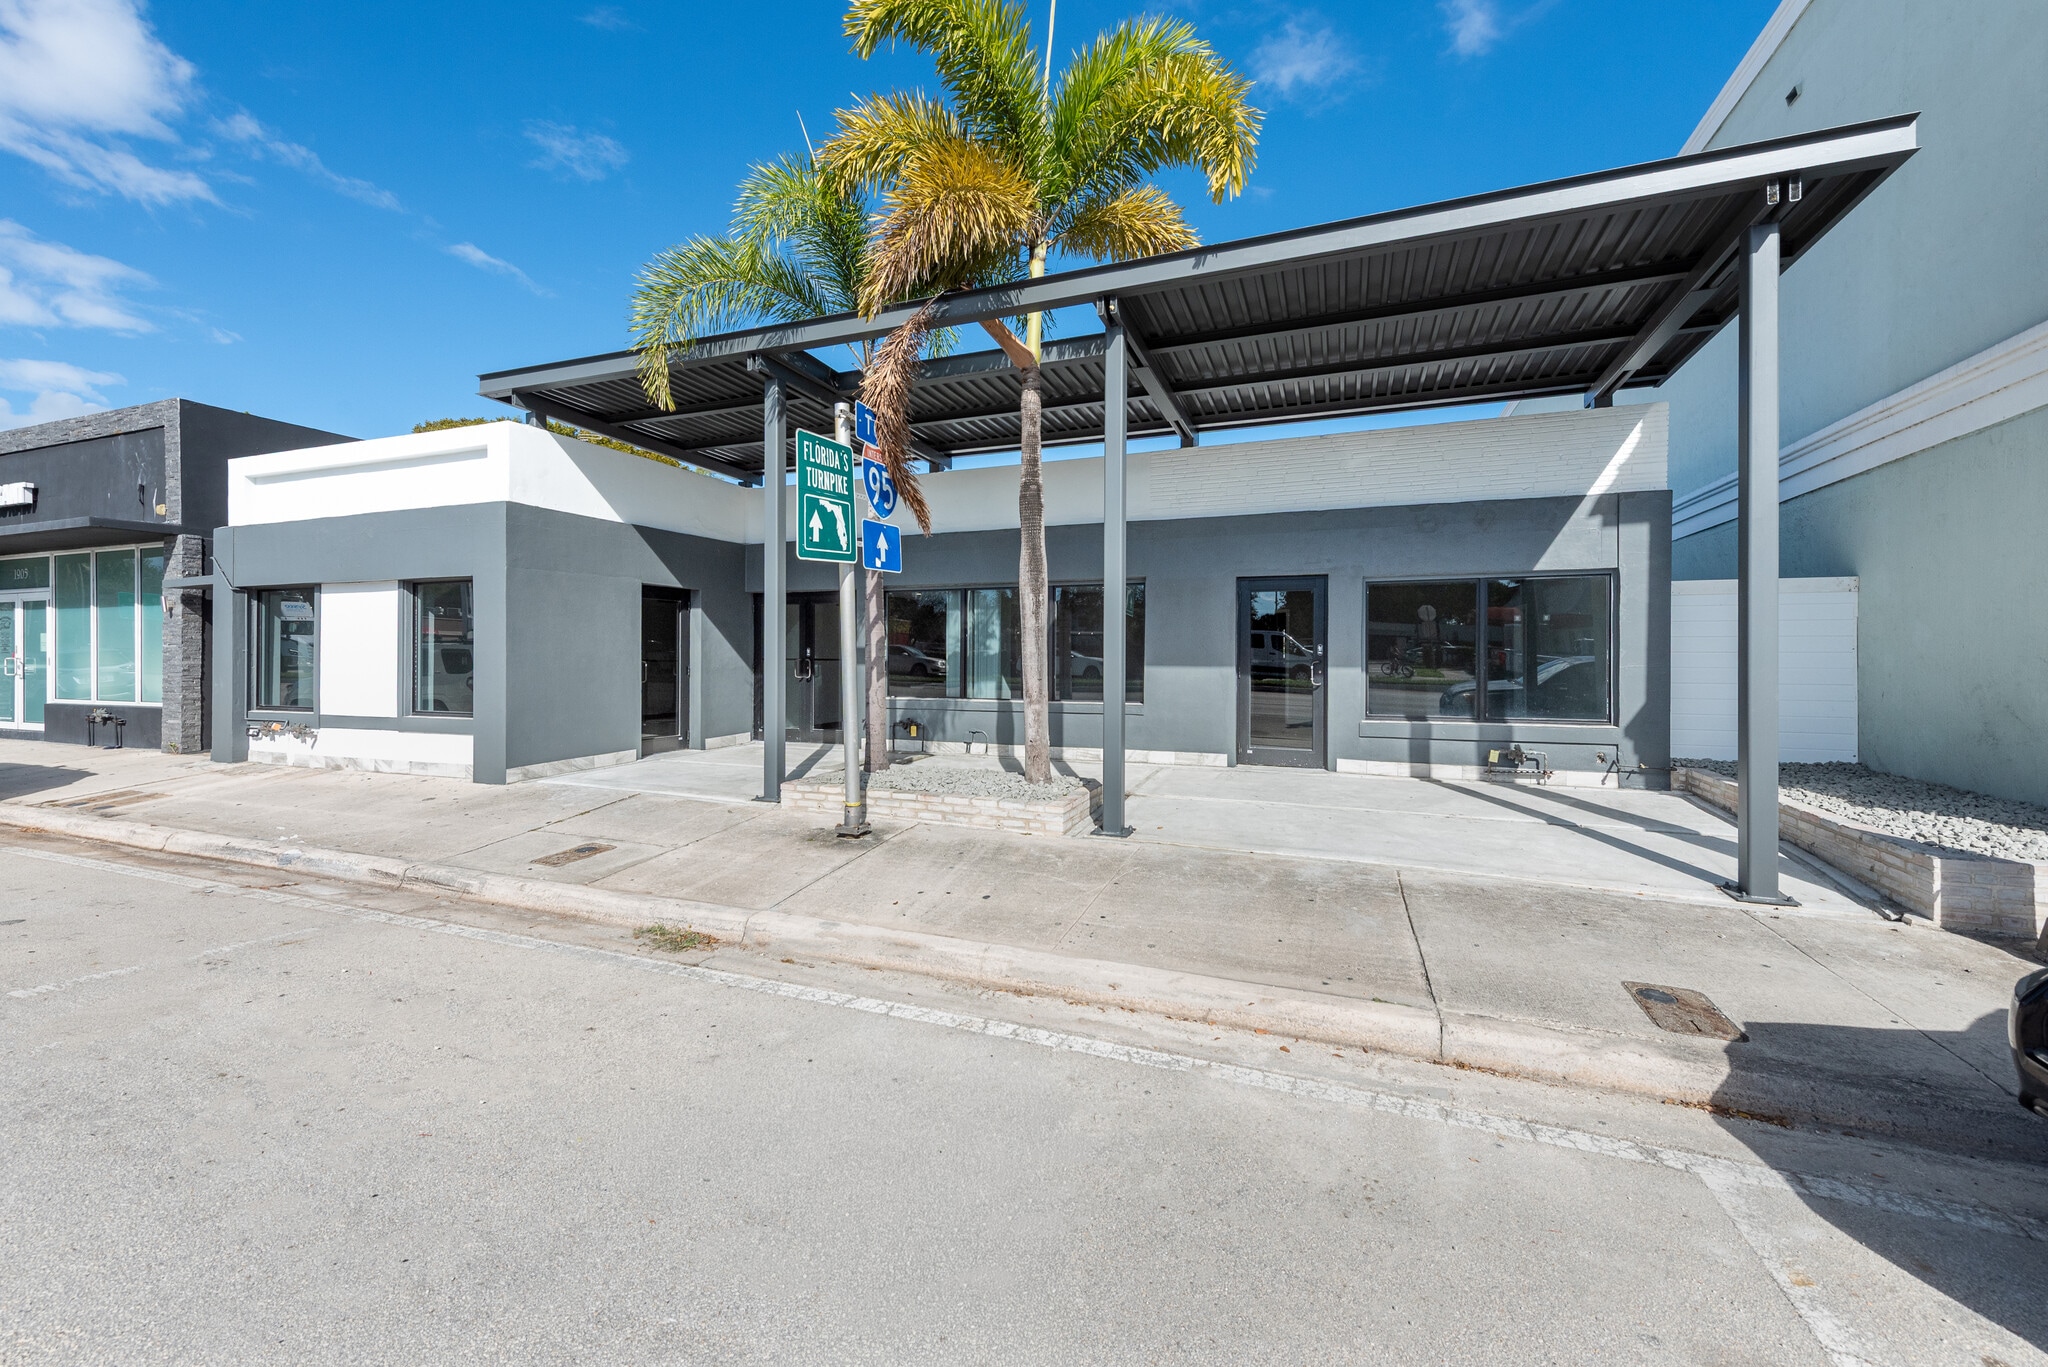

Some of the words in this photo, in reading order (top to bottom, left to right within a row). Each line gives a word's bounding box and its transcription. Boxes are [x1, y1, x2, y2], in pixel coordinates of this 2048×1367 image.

[803, 440, 849, 472] FLORIDA'S
[806, 466, 849, 495] TURNPIKE
[868, 466, 894, 510] 95
[13, 568, 29, 580] 1905
